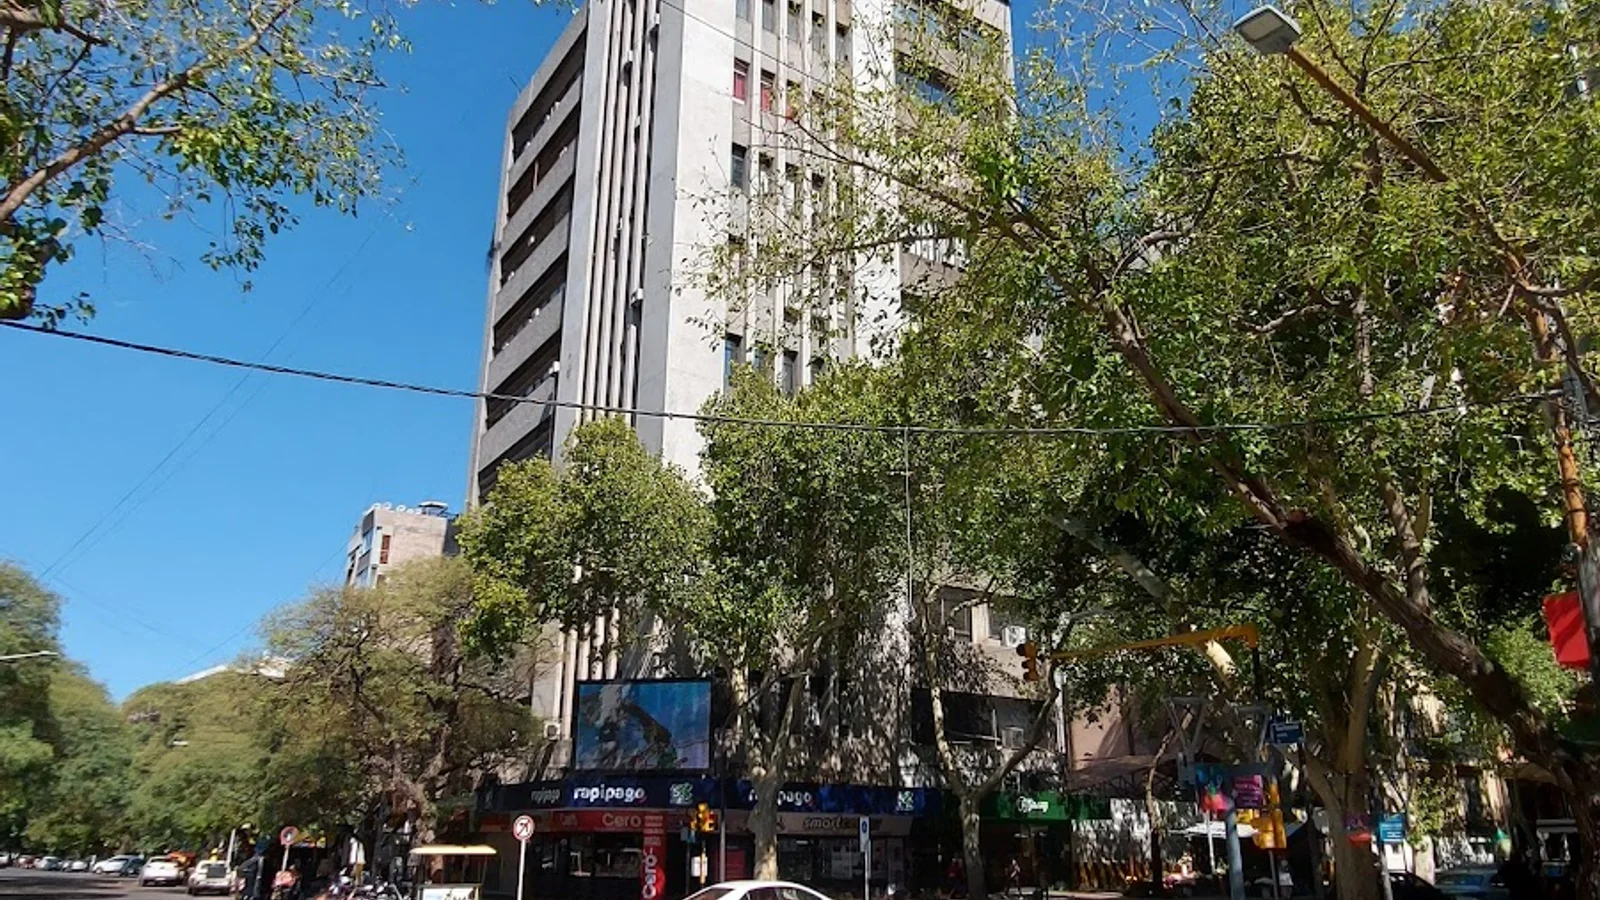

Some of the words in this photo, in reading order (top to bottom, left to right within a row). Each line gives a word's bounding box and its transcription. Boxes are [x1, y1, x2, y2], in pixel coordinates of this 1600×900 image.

[573, 784, 646, 803] rapipago
[749, 787, 813, 805] rpago
[601, 812, 642, 828] Cero
